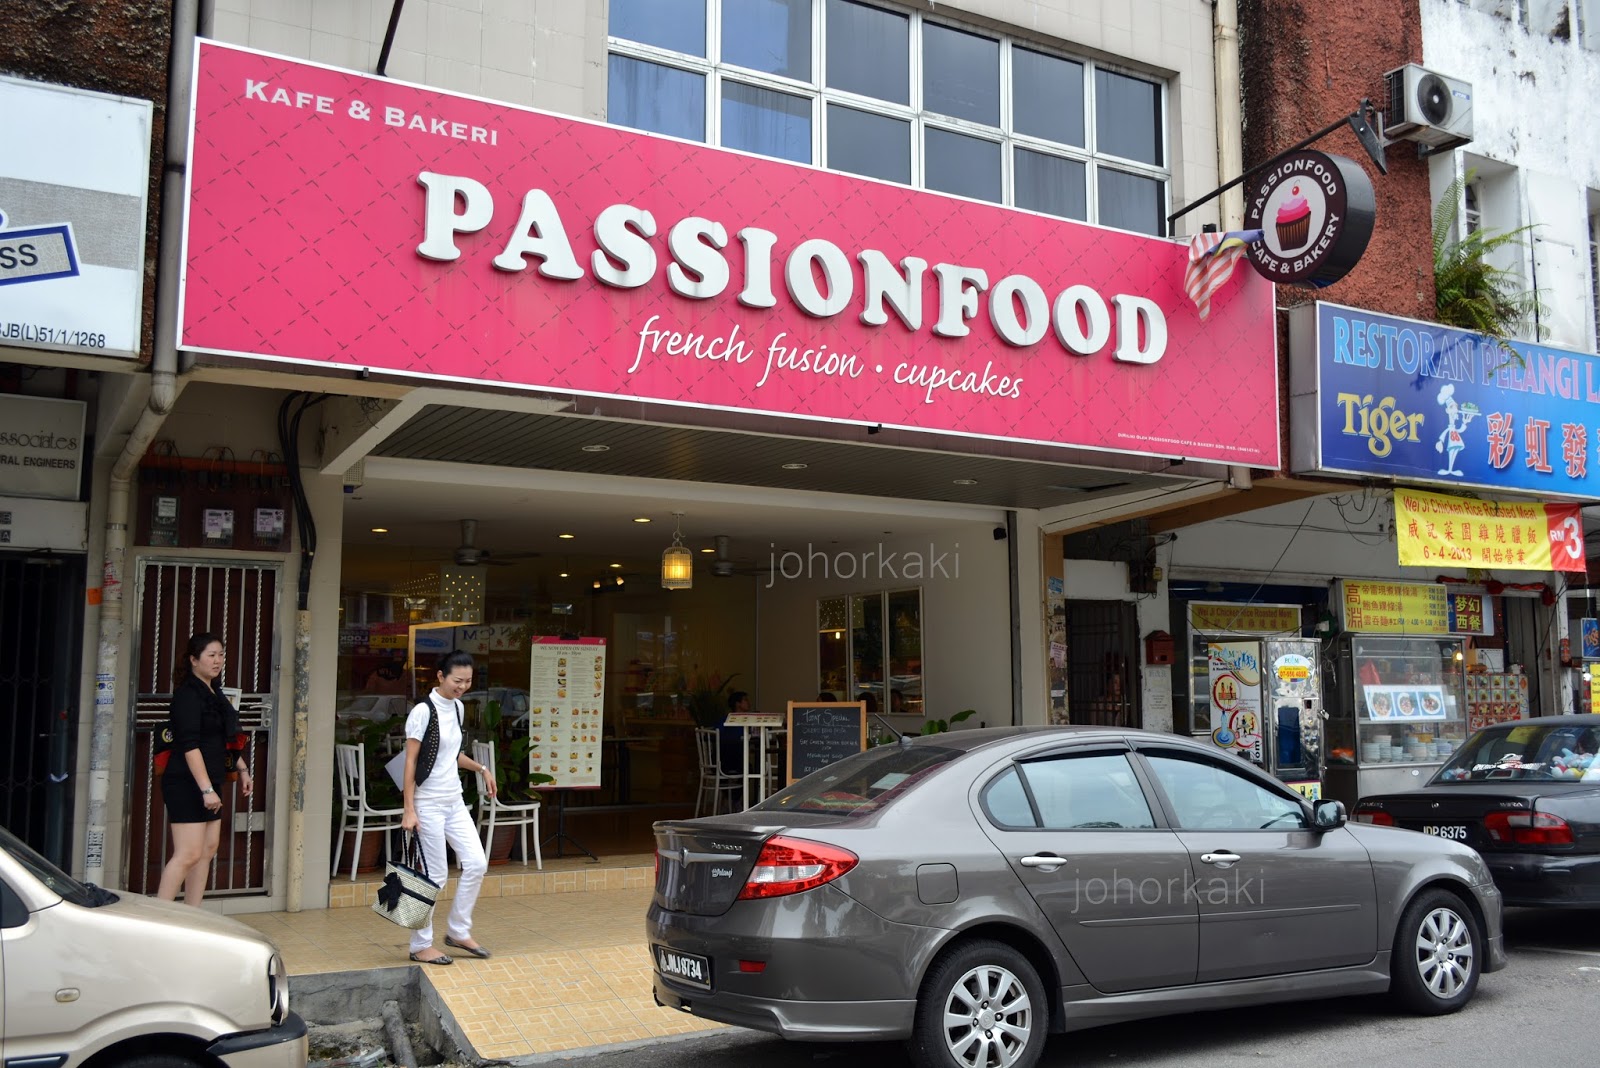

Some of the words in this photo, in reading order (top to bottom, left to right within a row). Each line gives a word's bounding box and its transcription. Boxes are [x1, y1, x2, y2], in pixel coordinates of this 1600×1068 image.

[245, 79, 334, 115] KAFE
[348, 100, 371, 122] &
[384, 106, 498, 146] BAKERI
[1251, 159, 1337, 220] PASSIONFOOD
[415, 171, 1168, 364] PASSIONFOOD
[1252, 240, 1279, 272] CAFE
[1280, 262, 1290, 274] &
[1293, 213, 1340, 272] BAKERY
[0, 323, 106, 348] JB(L)51/1/1268
[627, 315, 754, 374] french
[756, 332, 864, 388] fusion
[893, 361, 1024, 404] cupcakes
[1333, 316, 1475, 384] RESTORAN
[1481, 341, 1581, 401] PELANGI
[1148, 436, 1180, 444] PASSIONFOOD
[1337, 392, 1425, 458] Tiger
[1486, 411, 1600, 478] 彩虹發
[23, 456, 76, 470] ENGINEERS
[1404, 496, 1420, 513] Wei
[1422, 498, 1430, 514] Ji
[1430, 498, 1464, 516] Chicken
[1465, 501, 1483, 517] Rice
[1516, 505, 1538, 520] Meat
[1550, 529, 1564, 542] RM
[1564, 516, 1582, 560] 3
